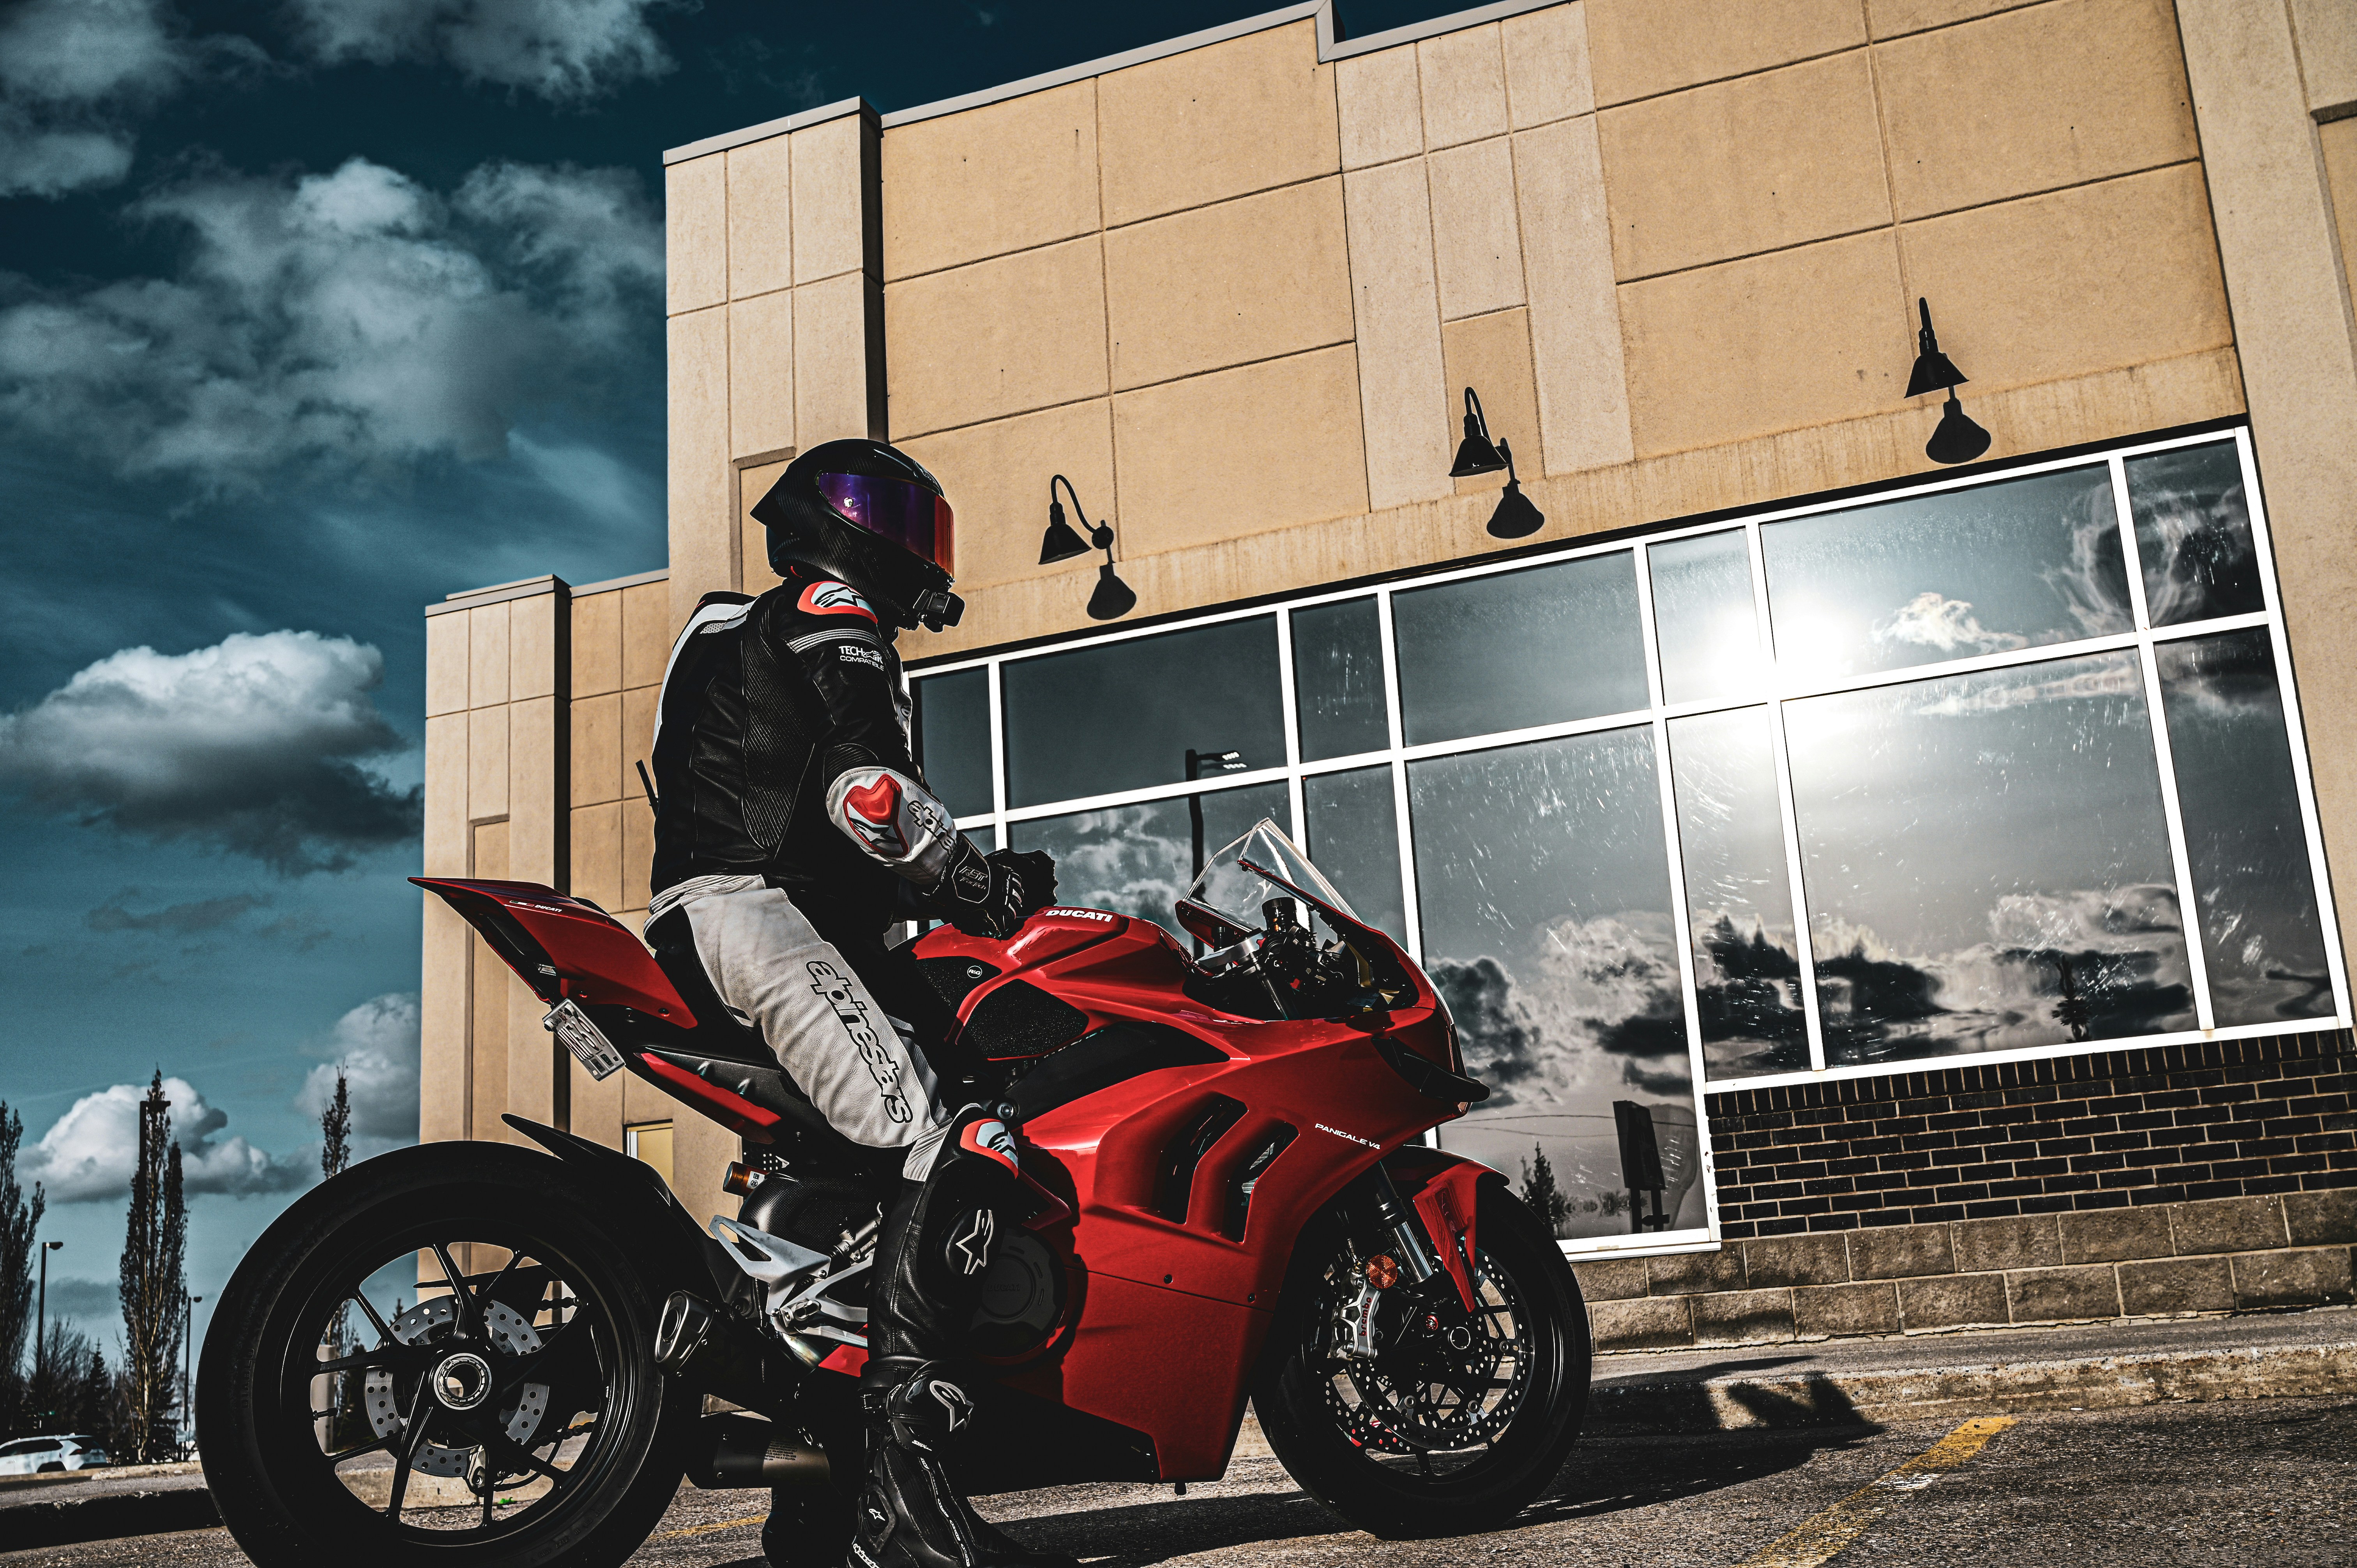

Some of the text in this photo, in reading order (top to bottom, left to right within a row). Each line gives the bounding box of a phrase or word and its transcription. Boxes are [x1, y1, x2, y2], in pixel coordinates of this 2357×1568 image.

[840, 655, 884, 671] COMPATIBLE
[959, 866, 988, 881] RST
[1045, 909, 1113, 922] DUCATI
[1315, 1123, 1380, 1150] PANIGALE V4
[1359, 1297, 1372, 1337] brembo
[239, 1349, 254, 1409] DIABLO
